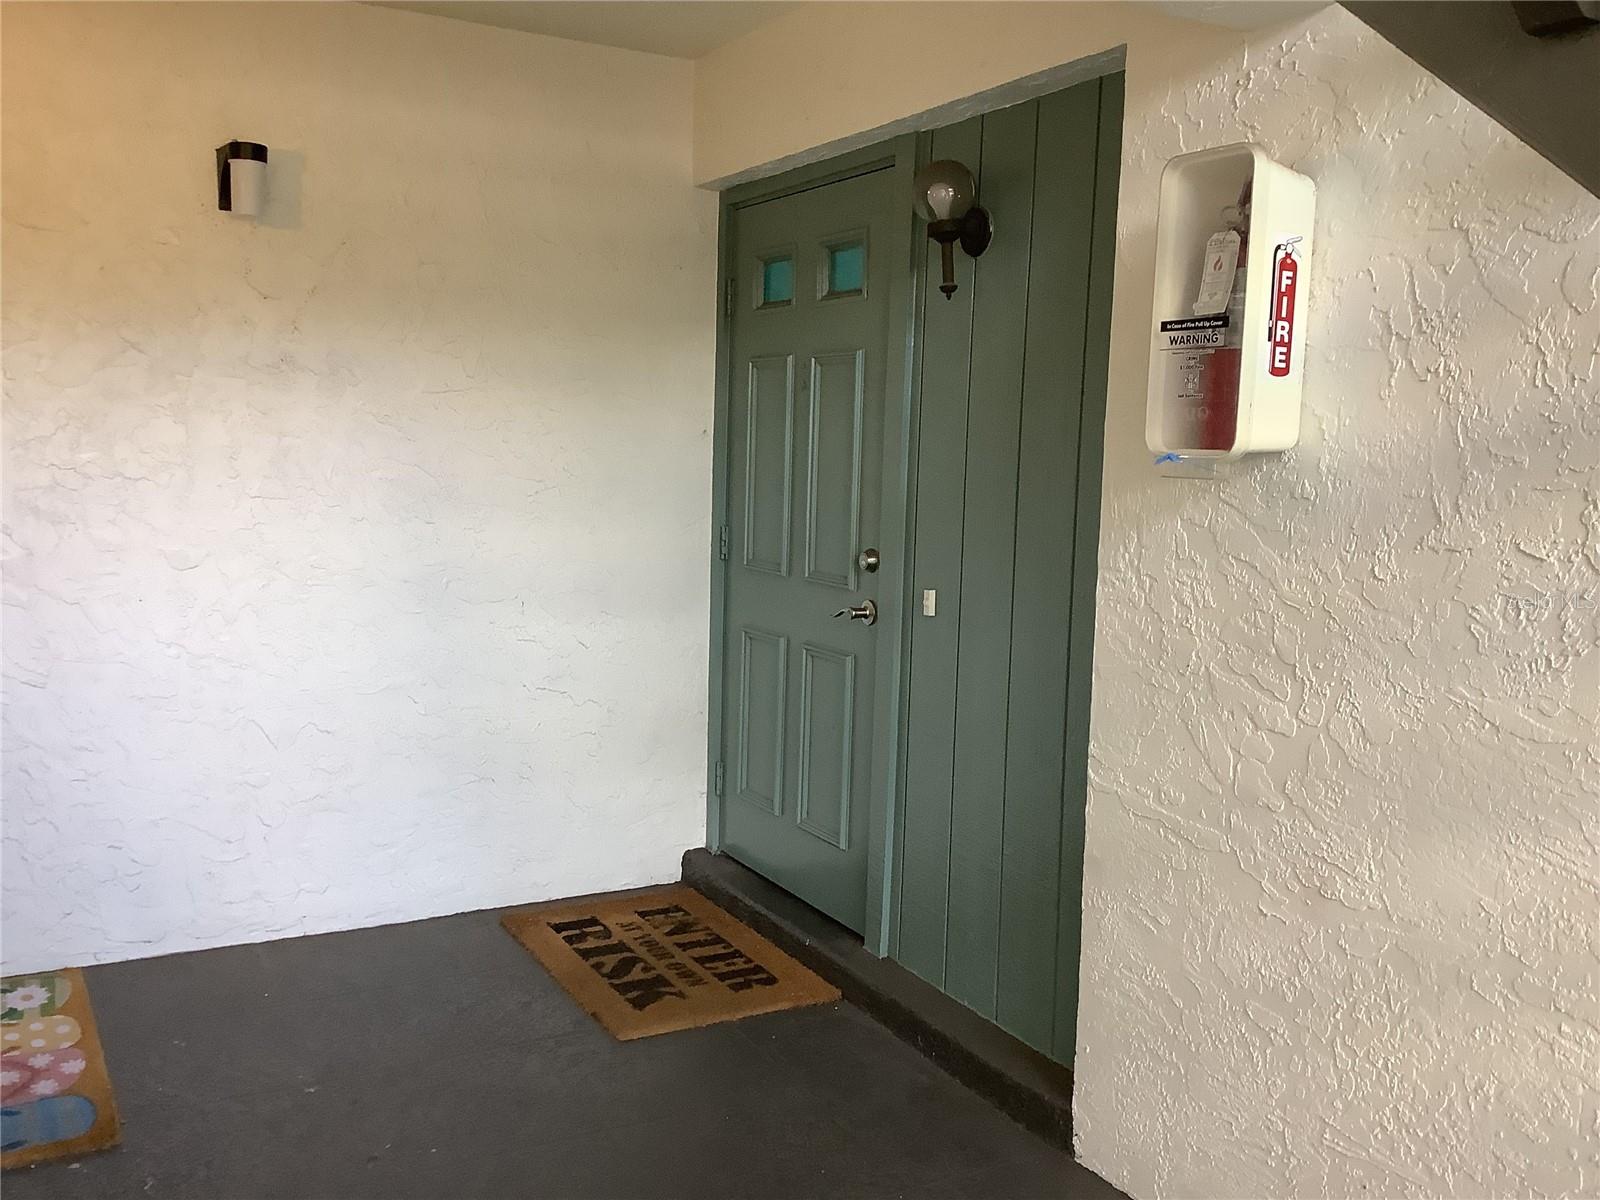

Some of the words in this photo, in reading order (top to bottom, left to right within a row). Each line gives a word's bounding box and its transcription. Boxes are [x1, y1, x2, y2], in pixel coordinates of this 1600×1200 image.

[1168, 332, 1219, 346] WARNING
[1204, 320, 1210, 328] Up
[1274, 270, 1293, 368] FIRE
[546, 915, 687, 1011] RISK
[634, 904, 779, 992] ENTER
